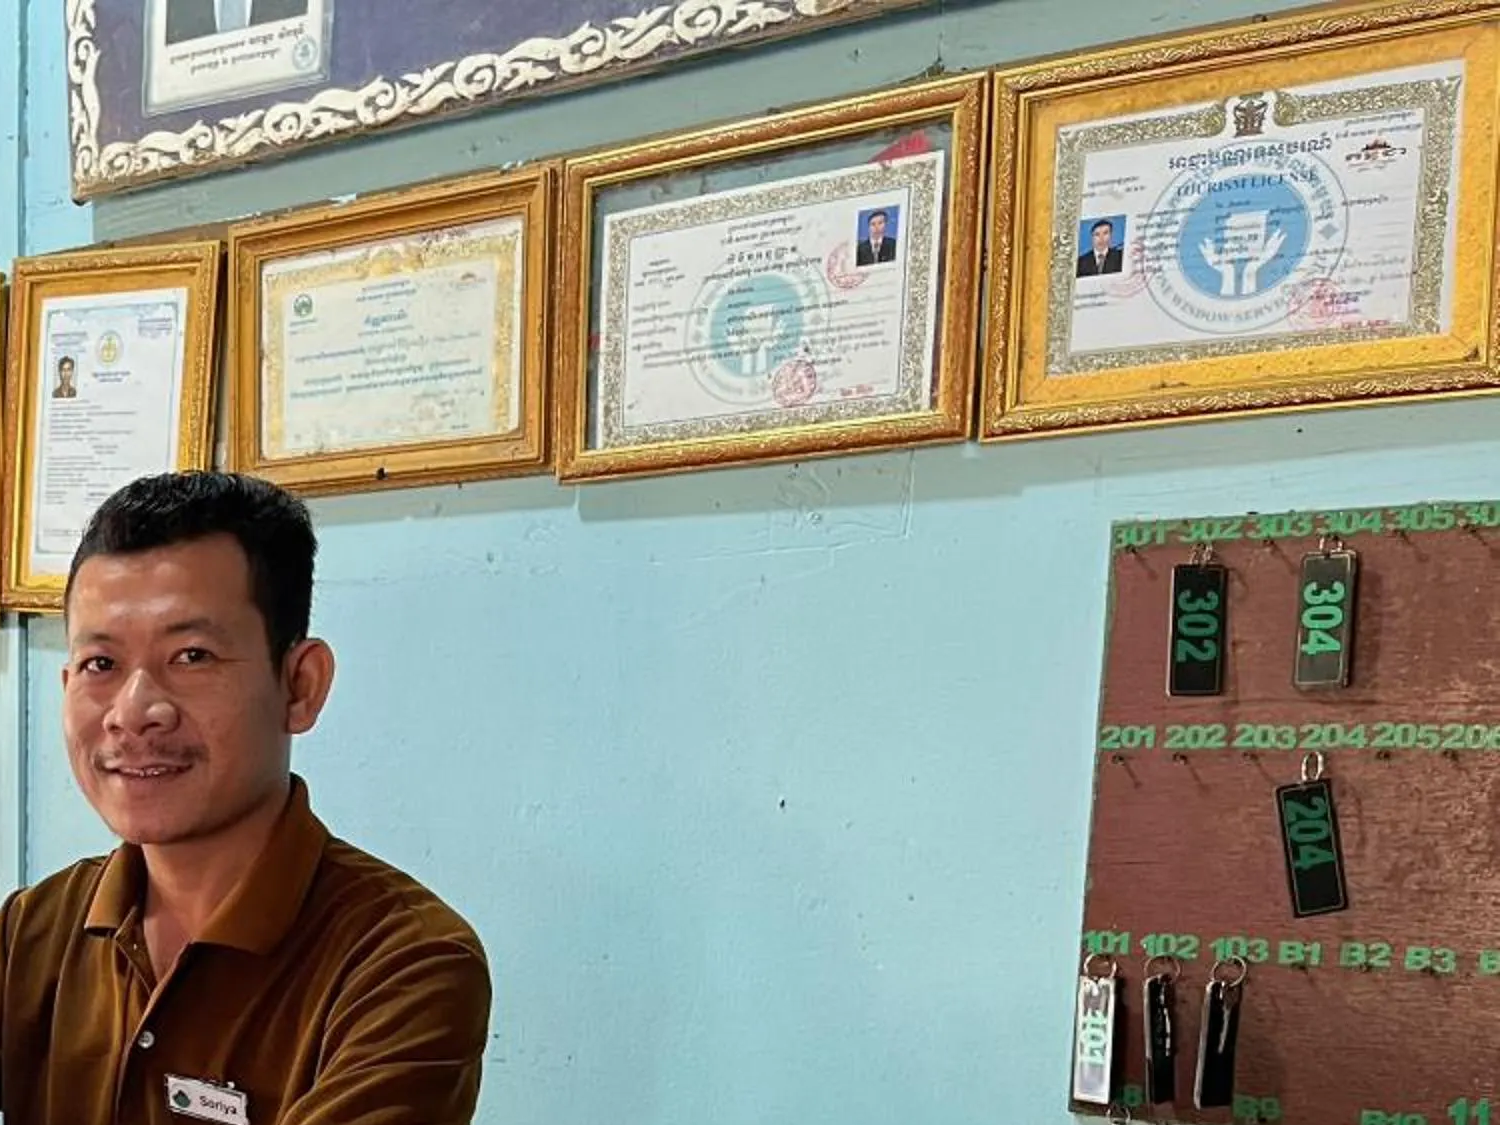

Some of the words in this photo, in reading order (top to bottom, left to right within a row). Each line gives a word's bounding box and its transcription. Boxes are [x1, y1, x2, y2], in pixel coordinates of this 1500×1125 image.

[1113, 519, 1166, 549] 301
[1179, 517, 1243, 543] 302
[1247, 512, 1312, 538] 303
[1315, 509, 1382, 536] 304
[1386, 505, 1455, 532] 305
[1176, 588, 1219, 663] 302
[1300, 581, 1345, 656] 304
[1100, 724, 1156, 750] 201
[1163, 723, 1228, 749] 202
[1231, 723, 1297, 749] 203
[1300, 723, 1368, 749] 204
[1371, 722, 1440, 748] 205
[1285, 796, 1337, 871] 204
[1084, 929, 1132, 955] 101
[1140, 933, 1199, 961] 102
[1209, 935, 1269, 963] 103
[1278, 940, 1322, 967] B1
[1340, 942, 1391, 968] B2
[1404, 946, 1457, 974] B3
[199, 1095, 237, 1115] Soriya
